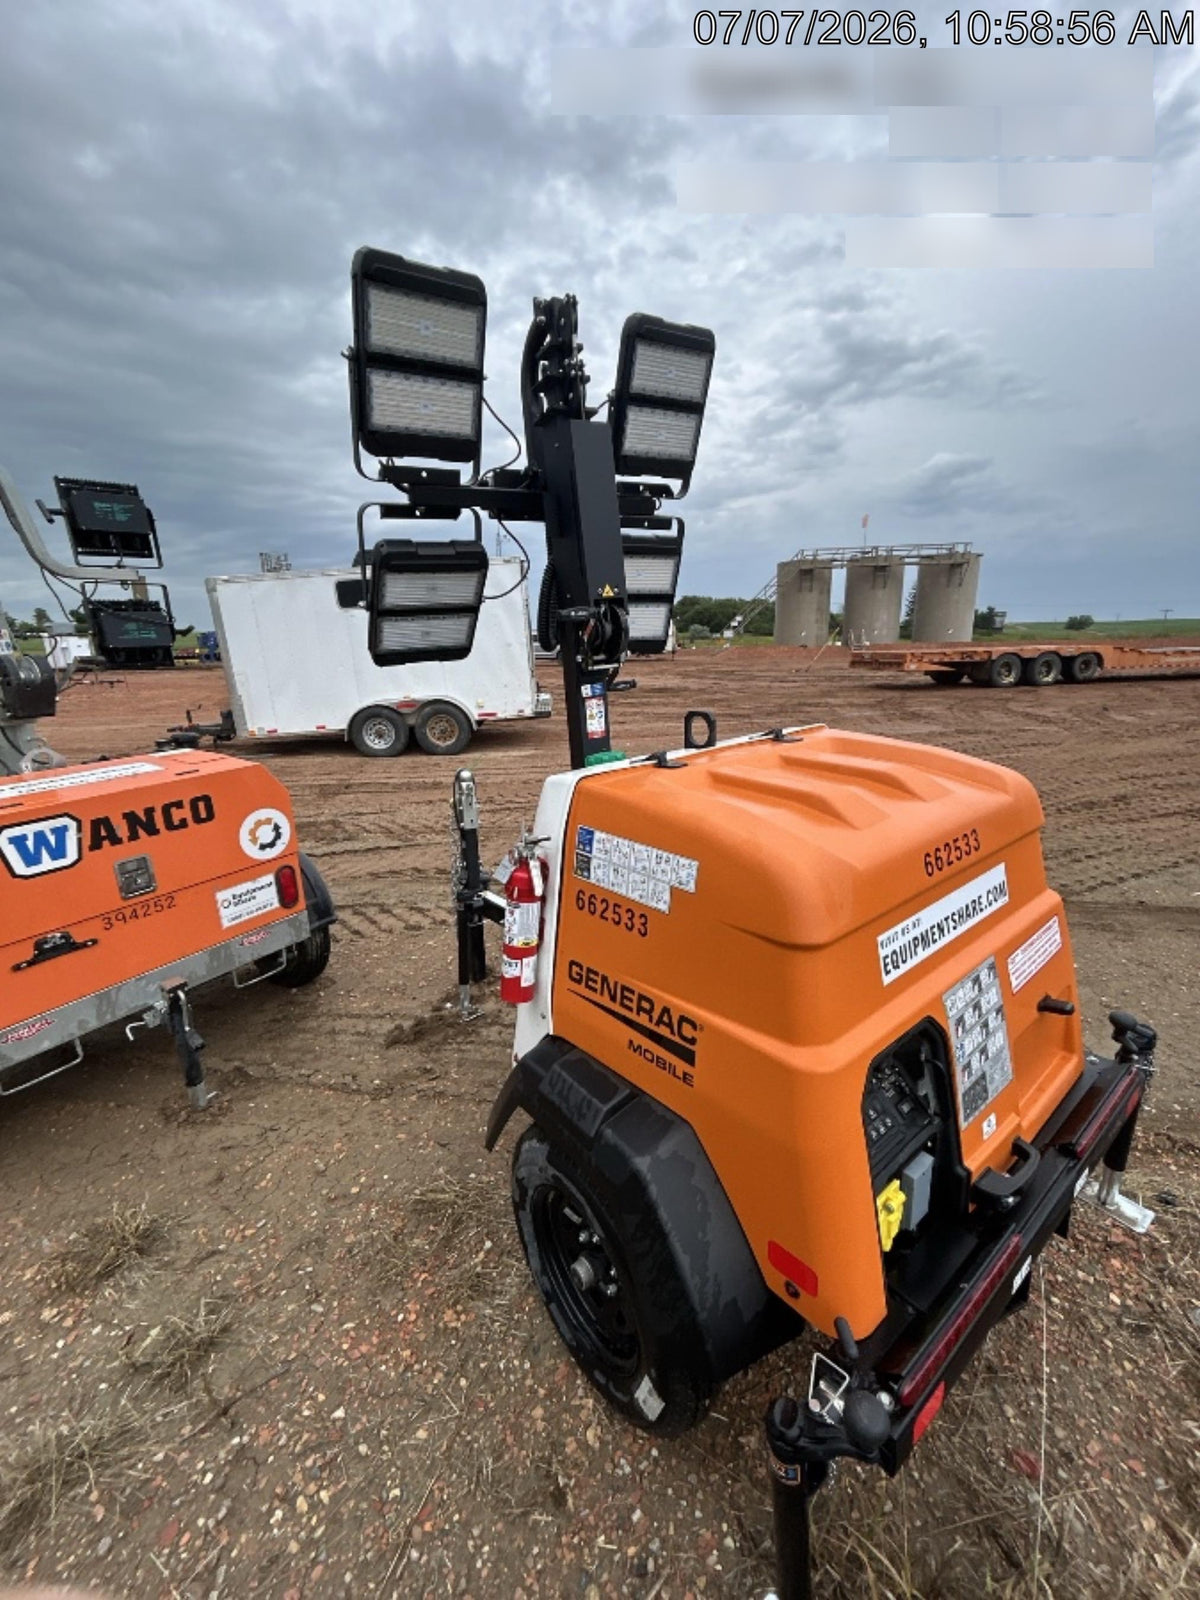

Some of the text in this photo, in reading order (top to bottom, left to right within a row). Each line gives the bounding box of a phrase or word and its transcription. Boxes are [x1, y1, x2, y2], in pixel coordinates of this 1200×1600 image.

[8, 794, 216, 869] WANCO
[923, 828, 981, 877] 662533
[101, 895, 177, 931] 394252
[575, 889, 649, 937] 662533
[882, 879, 1008, 977] EQUIPMENTSHARE.COM
[568, 959, 699, 1046] GENERAC
[627, 1038, 695, 1089] MOBILE
